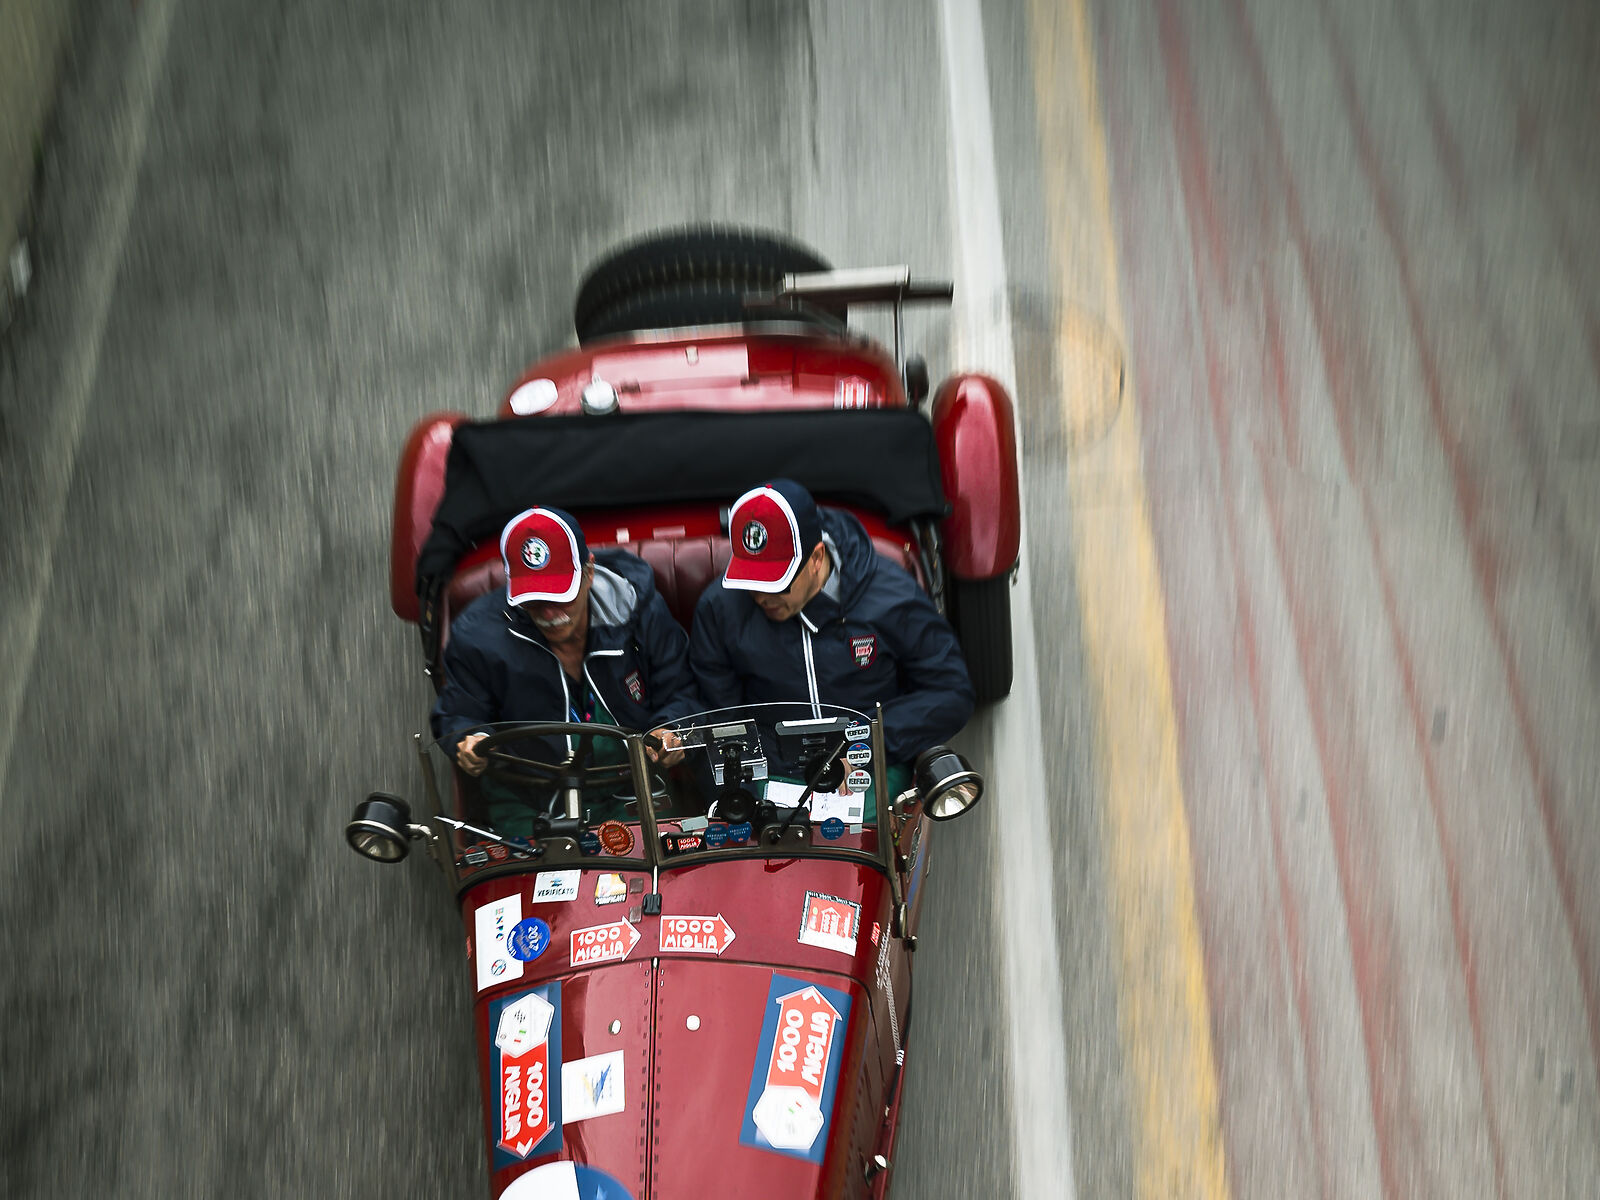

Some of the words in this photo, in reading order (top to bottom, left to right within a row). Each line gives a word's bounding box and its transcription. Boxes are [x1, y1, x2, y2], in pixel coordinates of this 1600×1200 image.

[537, 887, 574, 897] VERIFICATO
[578, 927, 621, 946] 1000
[668, 920, 715, 934] 1000
[575, 941, 624, 962] MIGLIA
[664, 934, 718, 949] MIGLIA
[777, 1009, 804, 1073] 1000
[800, 1011, 831, 1086] MIGLIA
[504, 1065, 522, 1140] MIGLIA
[526, 1061, 544, 1128] 1000
